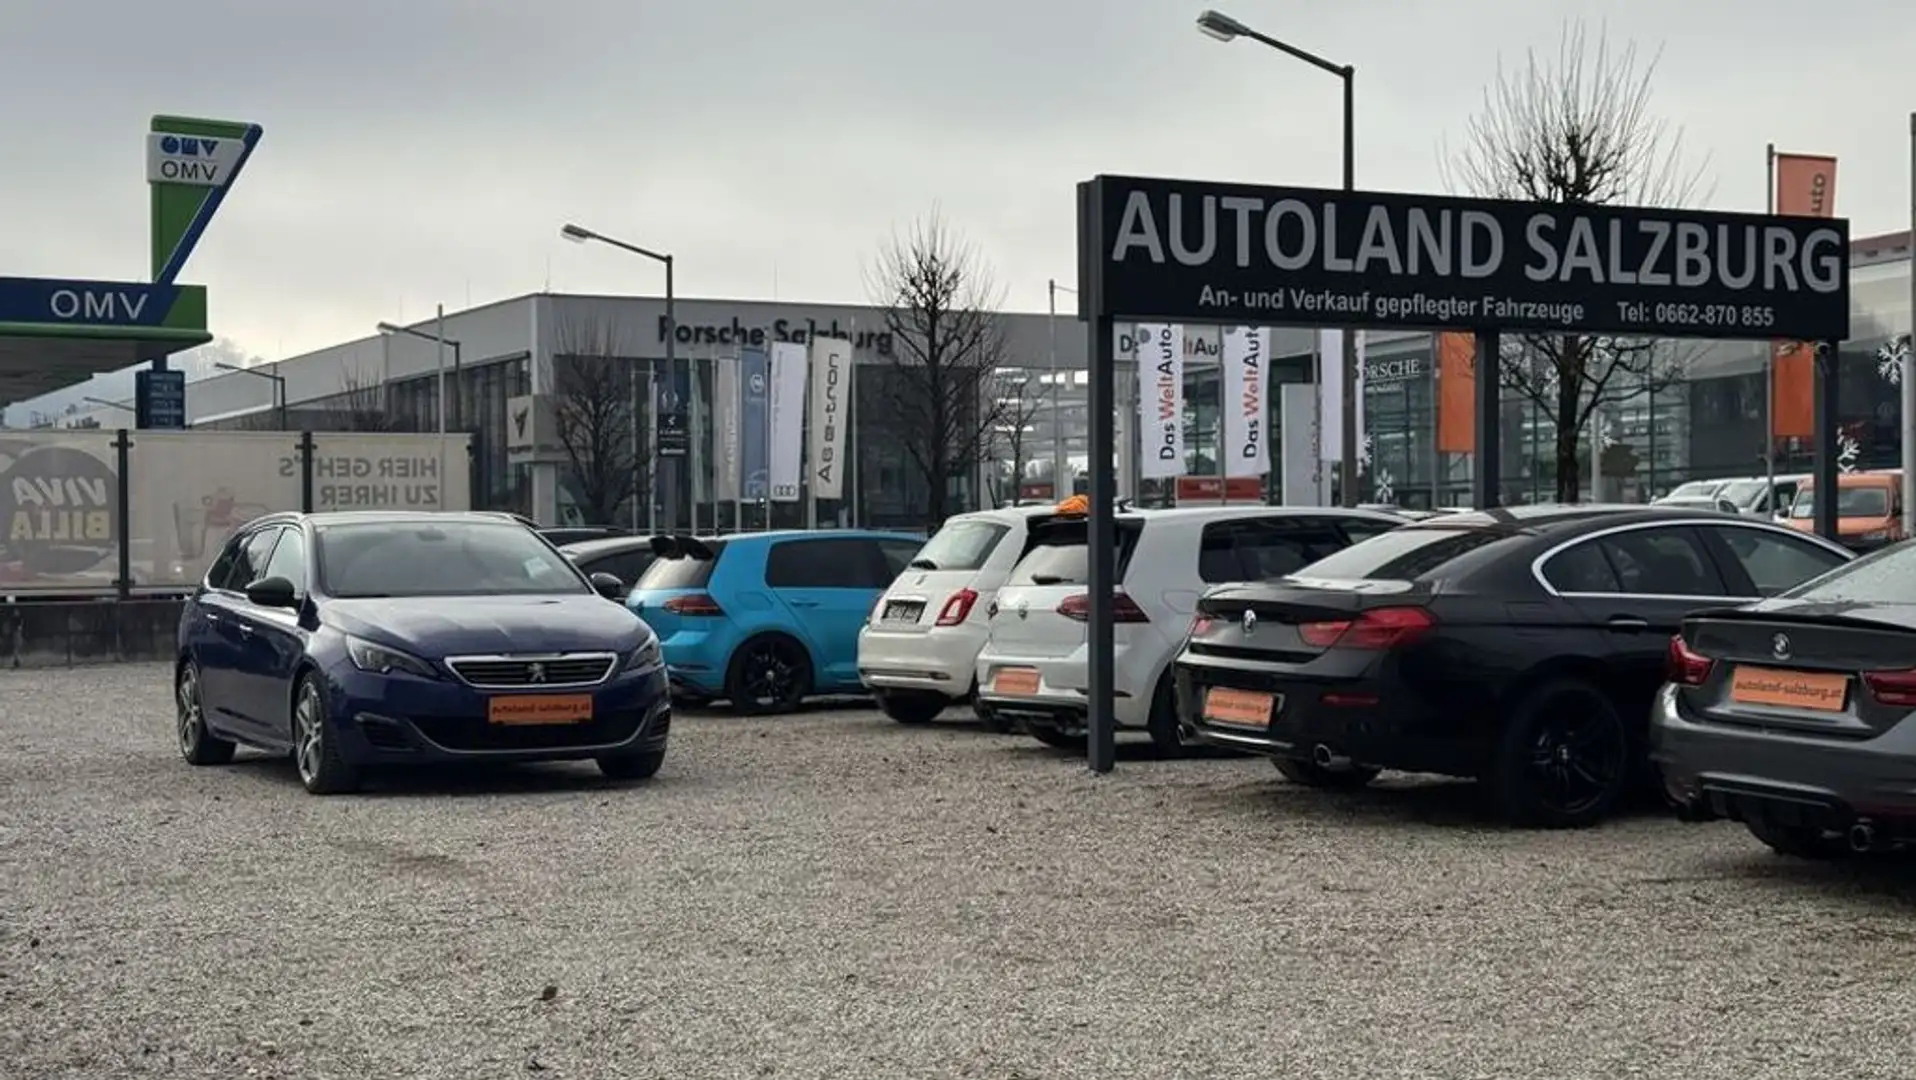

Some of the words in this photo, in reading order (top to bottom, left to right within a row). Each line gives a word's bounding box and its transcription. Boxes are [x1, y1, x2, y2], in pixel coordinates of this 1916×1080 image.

[161, 160, 217, 181] OMV
[1810, 172, 1827, 213] uto
[1112, 190, 1503, 277] AUTOLAND
[1524, 214, 1841, 293] SALZBURG
[50, 289, 149, 320] OMV
[1200, 285, 1237, 306] An-
[1244, 288, 1283, 309] und
[1291, 289, 1369, 313] Verkauf
[1376, 294, 1475, 321] gepflegter
[1482, 297, 1585, 324] Fahrzeuge
[1617, 301, 1649, 323] Tel:
[1655, 304, 1736, 325] 0662-870
[1741, 306, 1775, 326] 855
[1159, 422, 1175, 460] Das
[1243, 420, 1259, 458] Das
